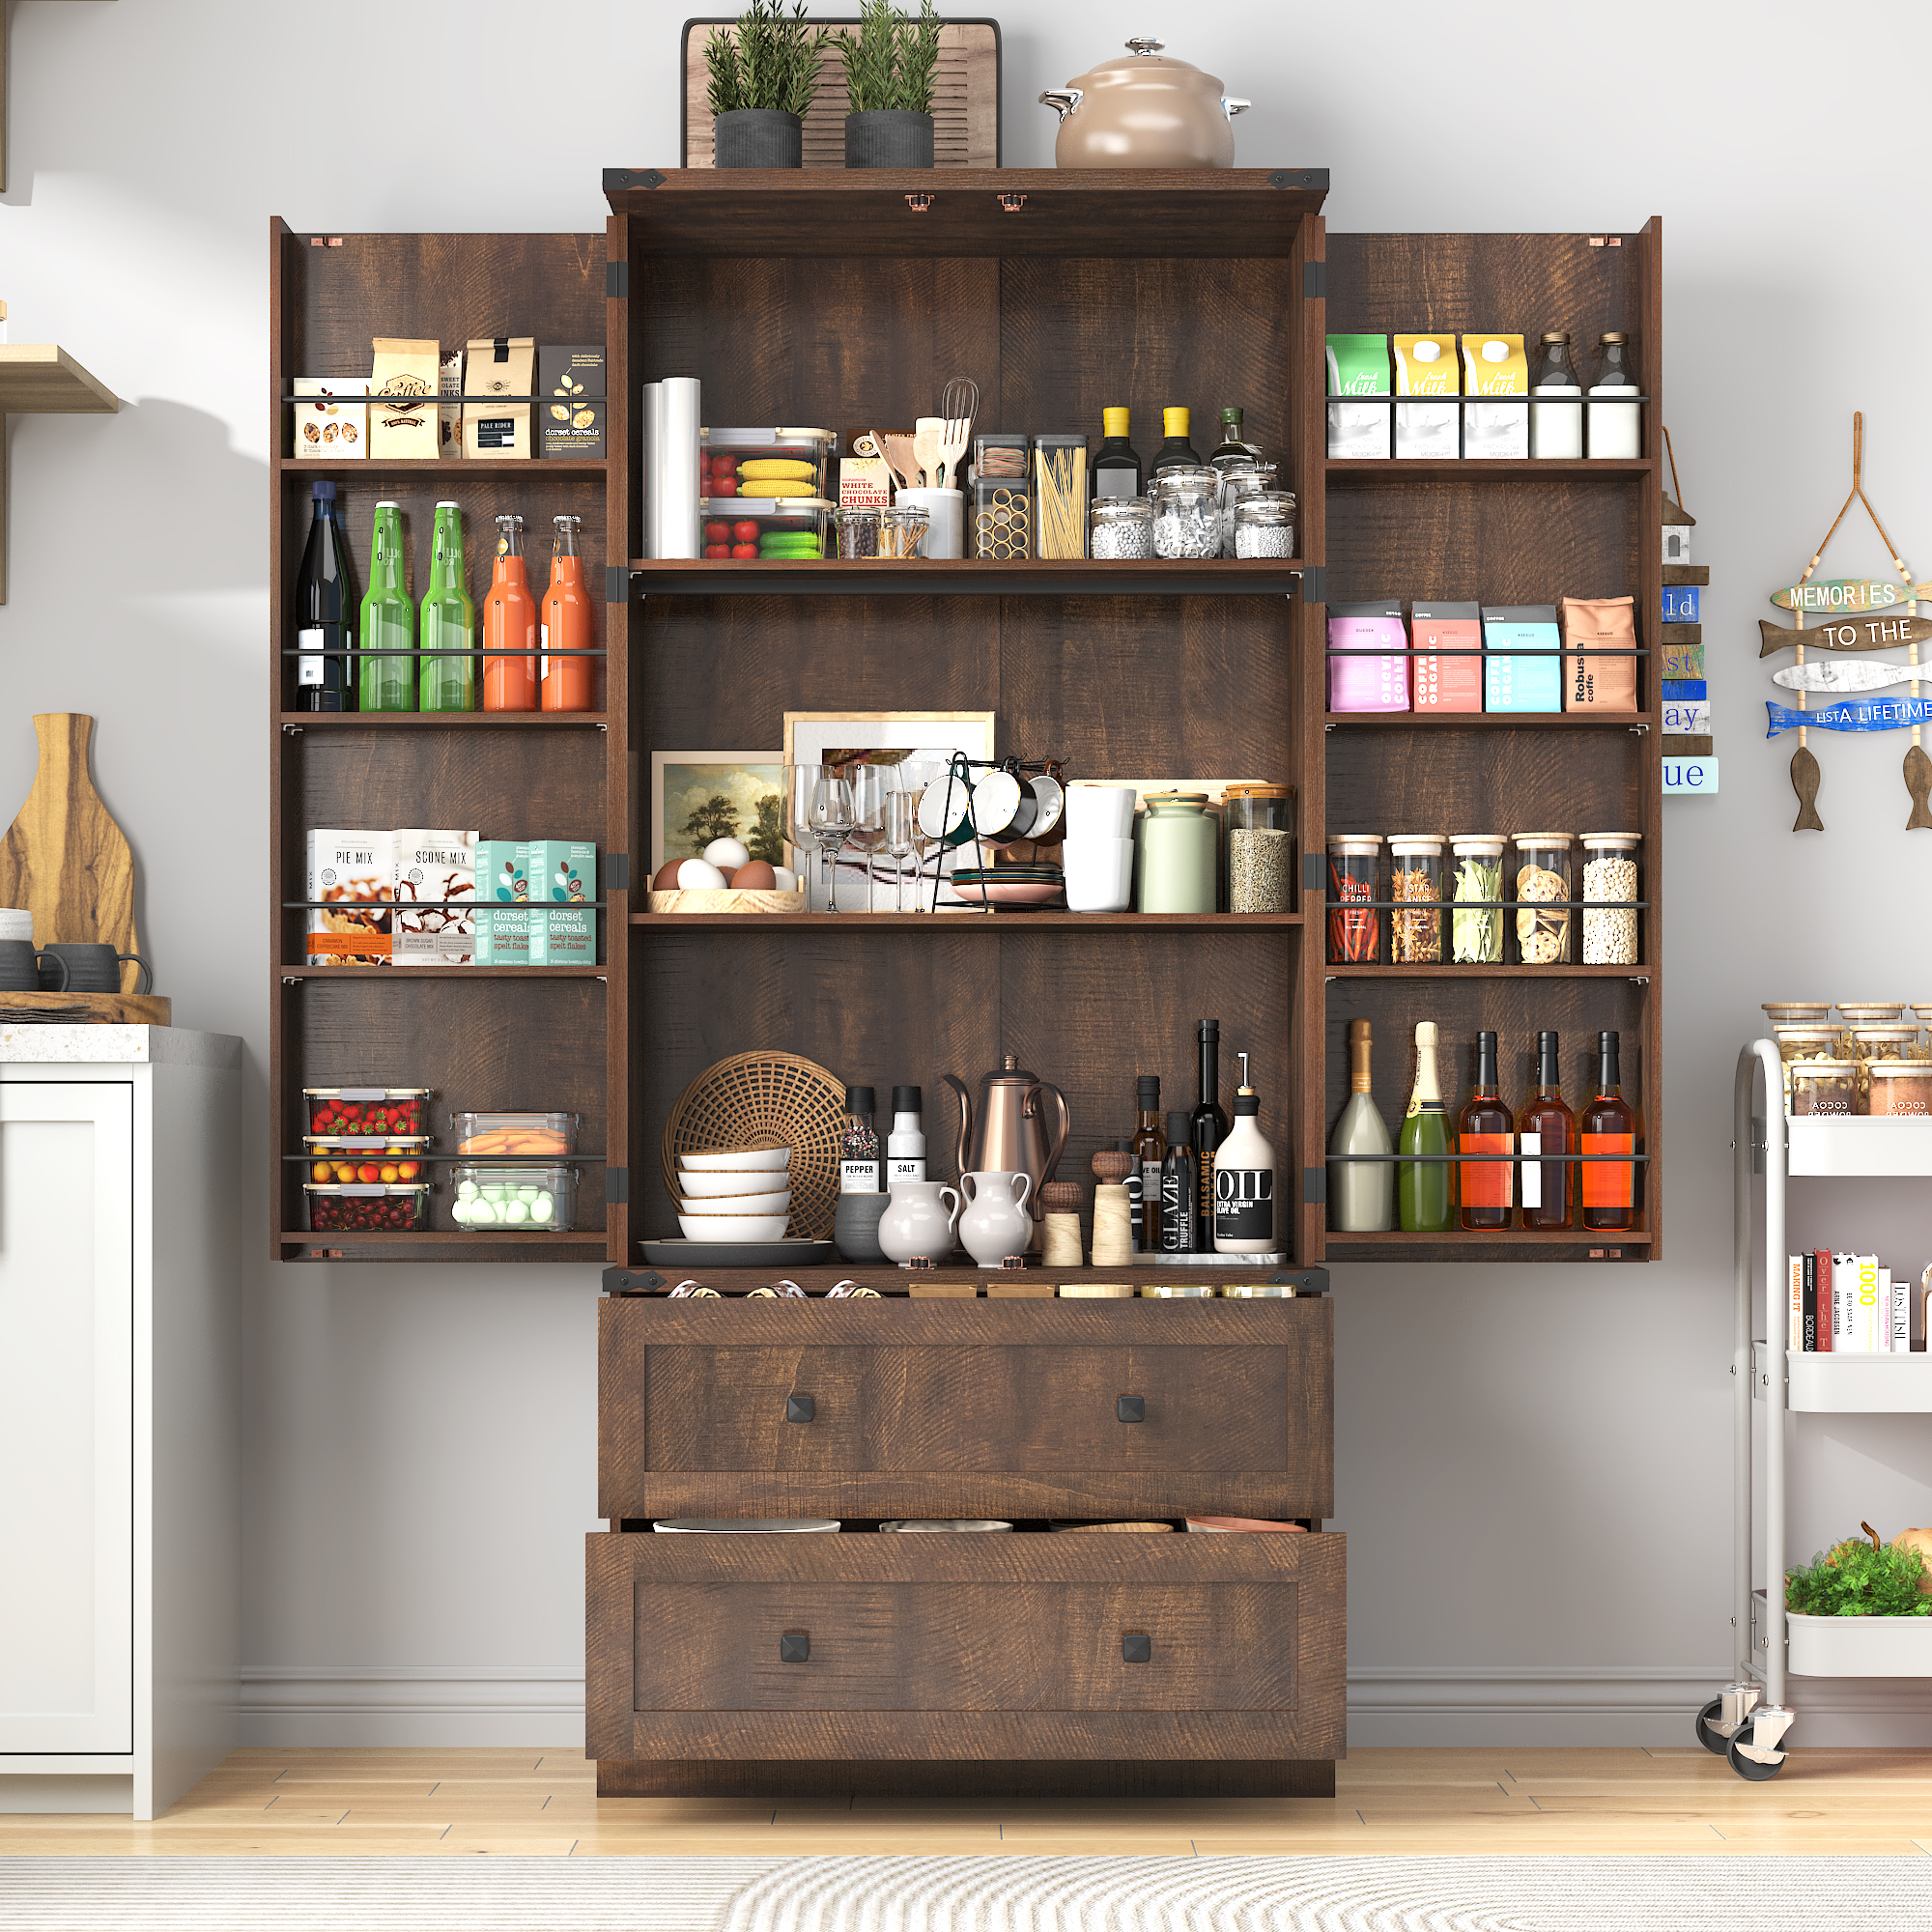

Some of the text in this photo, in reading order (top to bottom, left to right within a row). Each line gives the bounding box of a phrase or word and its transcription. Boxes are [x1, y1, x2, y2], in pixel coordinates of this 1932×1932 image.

[1356, 372, 1378, 382] fresh
[1425, 372, 1447, 382] fresh
[1493, 372, 1516, 382] fresh
[1342, 381, 1378, 395] Milk
[1410, 381, 1447, 395] Milk
[1479, 381, 1516, 395] Milk
[1790, 583, 1895, 607] MEMORIES
[1662, 593, 1693, 615] ld
[1823, 619, 1913, 647] TO THE
[1662, 653, 1693, 671] st
[1576, 642, 1584, 702] Robusa
[1418, 655, 1428, 704] COFFE
[1859, 701, 1932, 722] LIFETIME
[336, 851, 373, 865] PIE MIX
[415, 850, 467, 865] SCONE MIX
[1342, 884, 1370, 893] CHILLI
[1408, 884, 1430, 893] STAR
[493, 910, 529, 921] dorset
[549, 910, 582, 921] dorset
[549, 923, 587, 933] cereals
[1201, 1151, 1210, 1217] BALSAMIC
[1217, 1170, 1272, 1201] OIL
[1162, 1175, 1179, 1250] GLAZE
[1179, 1211, 1189, 1249] TRUFFLE
[1860, 1263, 1877, 1306] 1000
[1793, 1302, 1801, 1313] IT
